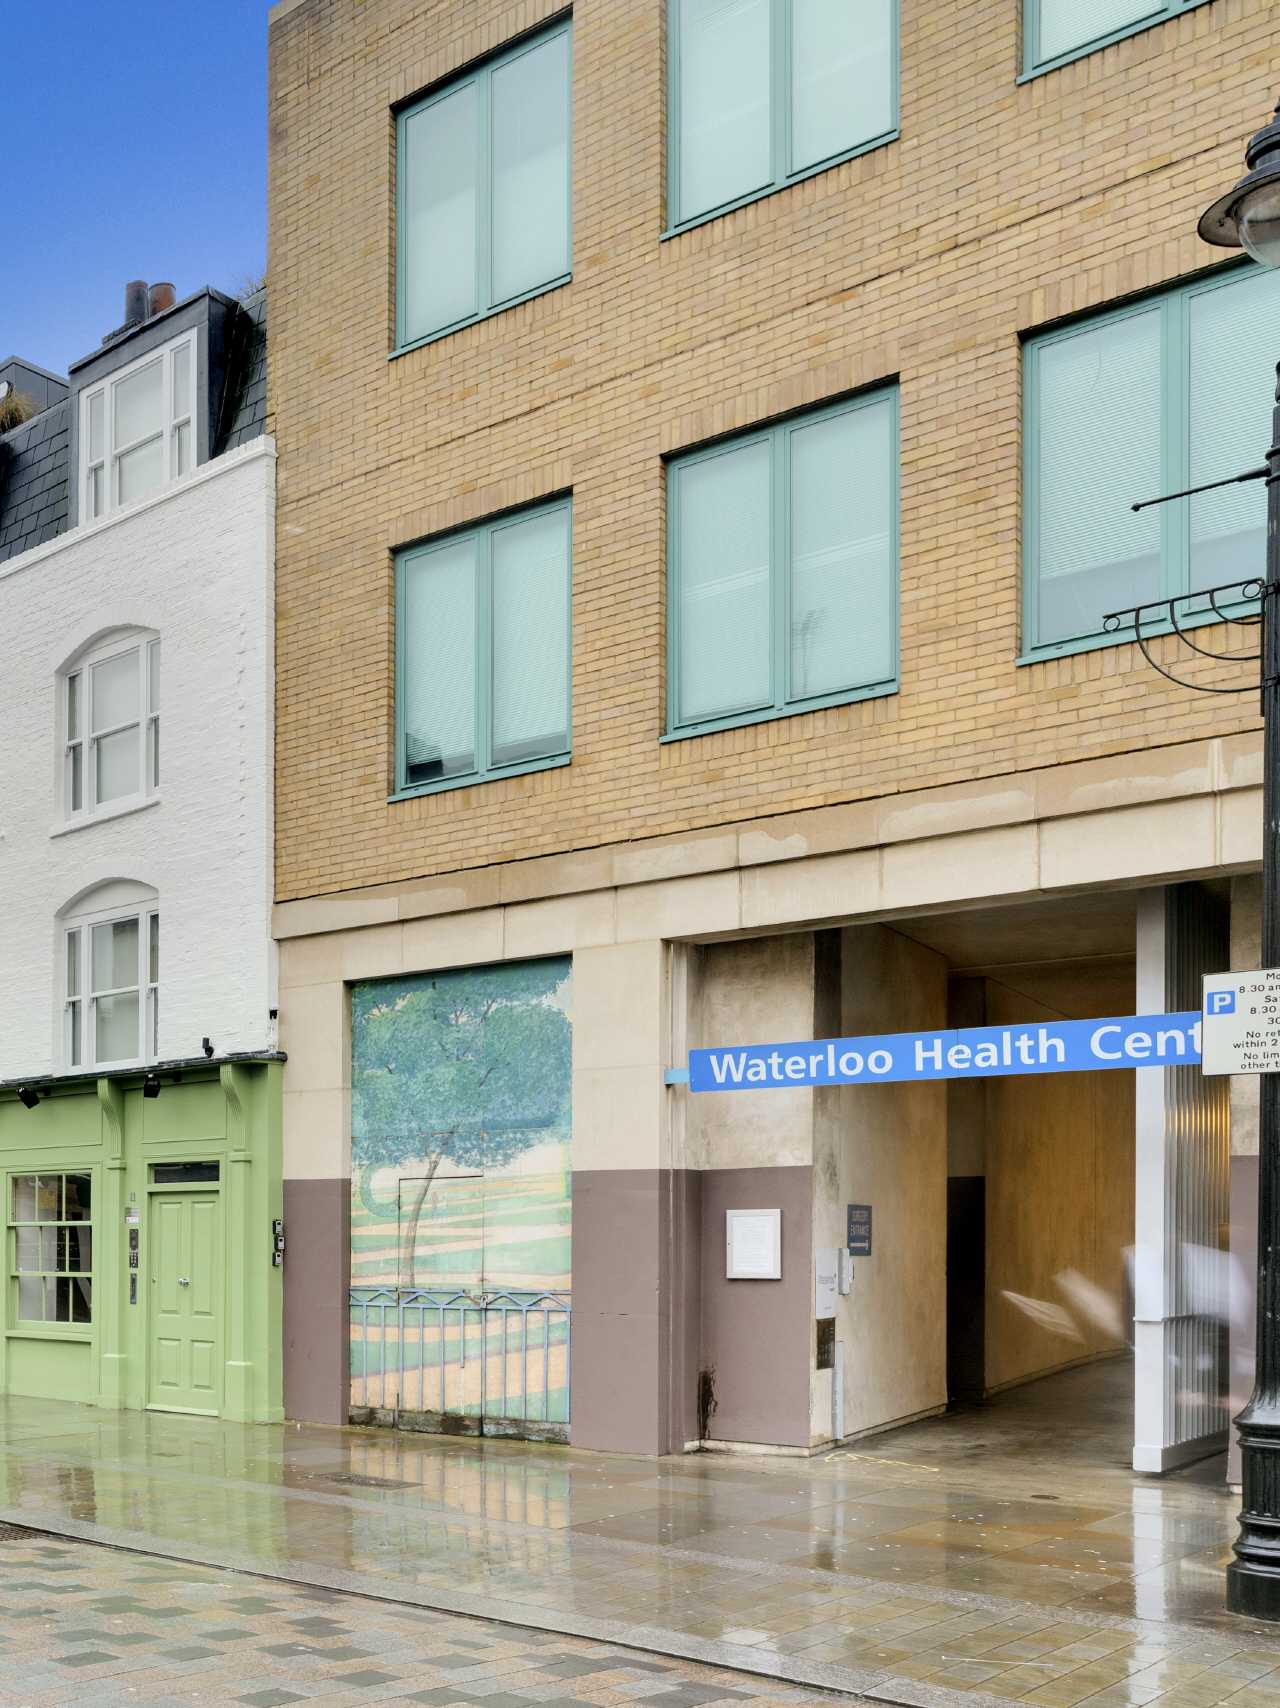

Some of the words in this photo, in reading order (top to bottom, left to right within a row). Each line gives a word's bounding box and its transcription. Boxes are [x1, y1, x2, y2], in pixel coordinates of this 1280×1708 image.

[1213, 993, 1231, 1013] P
[1264, 995, 1280, 1003] Sa
[1246, 1031, 1261, 1039] No
[1232, 1040, 1267, 1048] within
[1271, 1038, 1278, 1046] 2
[709, 1044, 894, 1083] Waterloo
[914, 1028, 1066, 1071] Health
[1090, 1021, 1202, 1061] Cent
[1243, 1052, 1259, 1060] No
[1240, 1061, 1270, 1070] other
